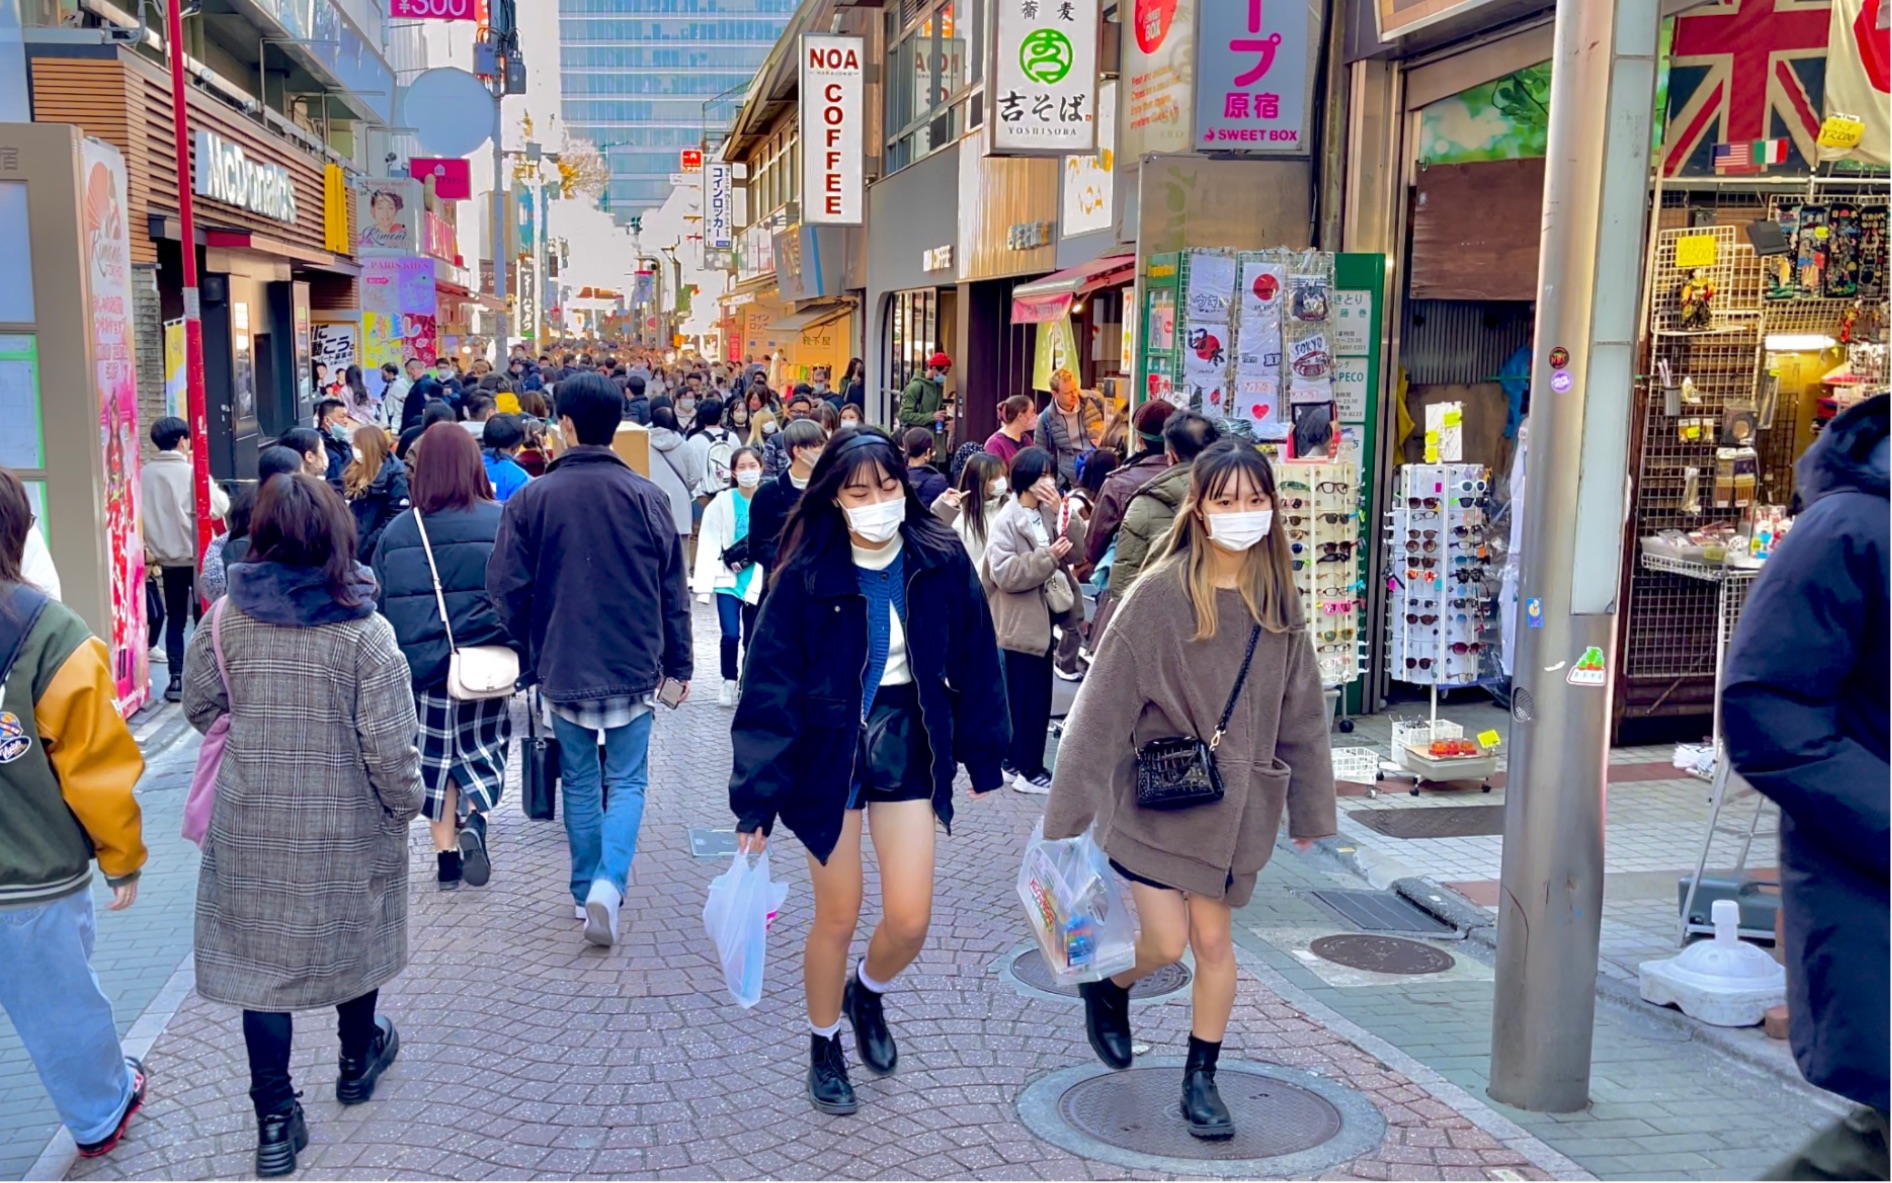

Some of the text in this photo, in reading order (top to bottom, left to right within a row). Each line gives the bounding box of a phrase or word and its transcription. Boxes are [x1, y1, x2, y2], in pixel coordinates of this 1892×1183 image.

[809, 49, 859, 69] NOA
[997, 91, 1086, 122] 吉そば
[1224, 92, 1280, 119] 原宿
[1008, 127, 1077, 136] YOSHISOBA
[1218, 129, 1297, 142] SWEET BOX
[824, 83, 844, 215] COFFEE
[712, 167, 723, 238] コインロッカー
[371, 261, 400, 269] PARIS
[749, 314, 769, 322] コイン
[1339, 371, 1364, 382] PECO
